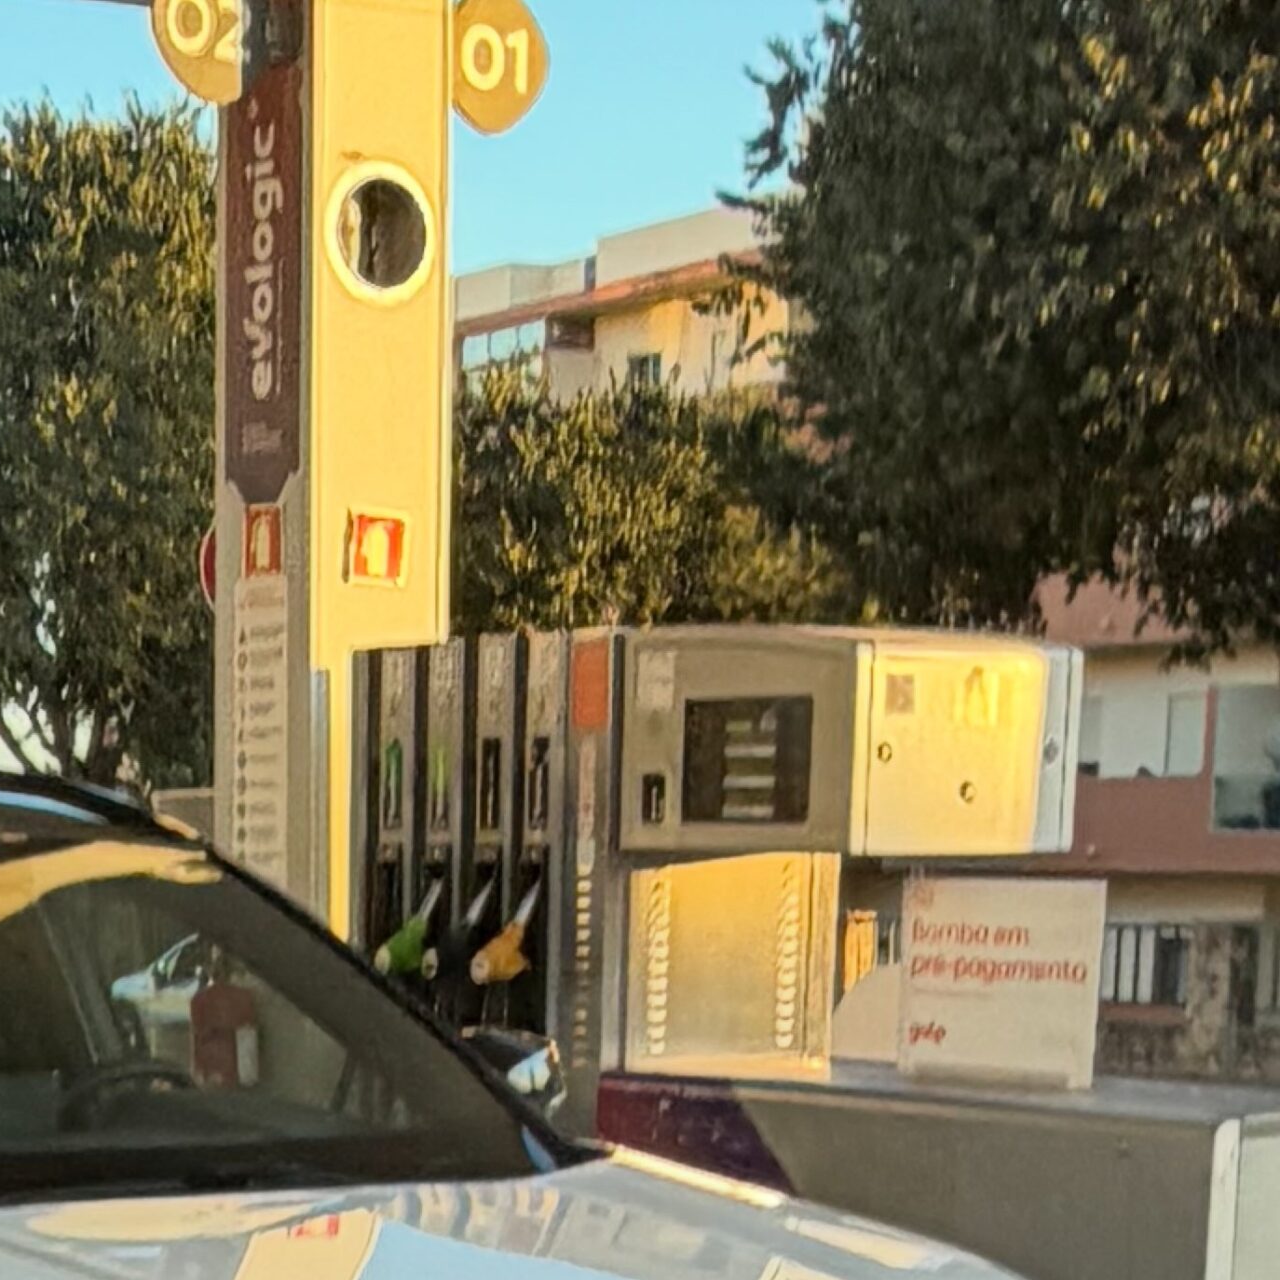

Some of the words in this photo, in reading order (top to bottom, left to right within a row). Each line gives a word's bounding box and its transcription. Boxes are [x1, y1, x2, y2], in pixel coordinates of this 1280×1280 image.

[166, 0, 251, 64] 02
[460, 23, 529, 94] 01
[243, 122, 283, 401] evologic
